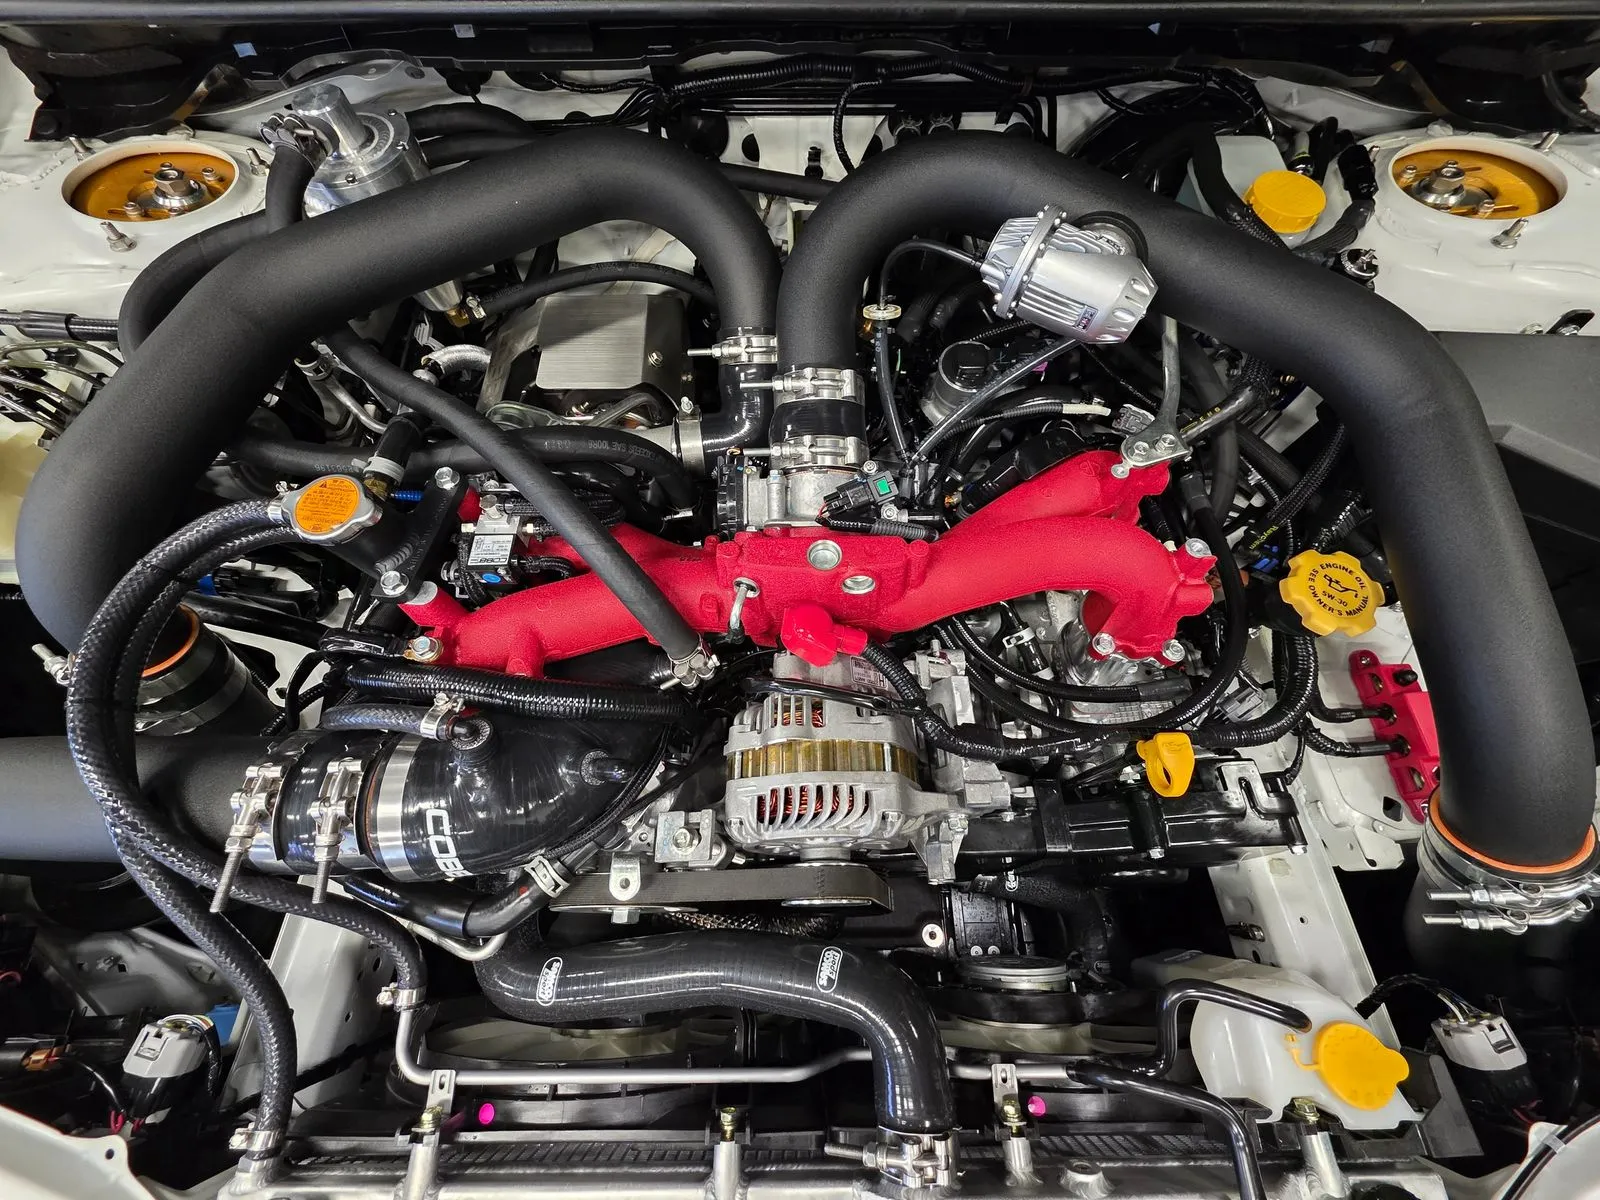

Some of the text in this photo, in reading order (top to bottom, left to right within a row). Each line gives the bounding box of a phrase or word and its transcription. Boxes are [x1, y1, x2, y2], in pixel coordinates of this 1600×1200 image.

[1308, 568, 1369, 617] SEE OWNER'S MANUAL
[1320, 562, 1367, 590] ENGINE OIL
[425, 808, 475, 878] COBB
